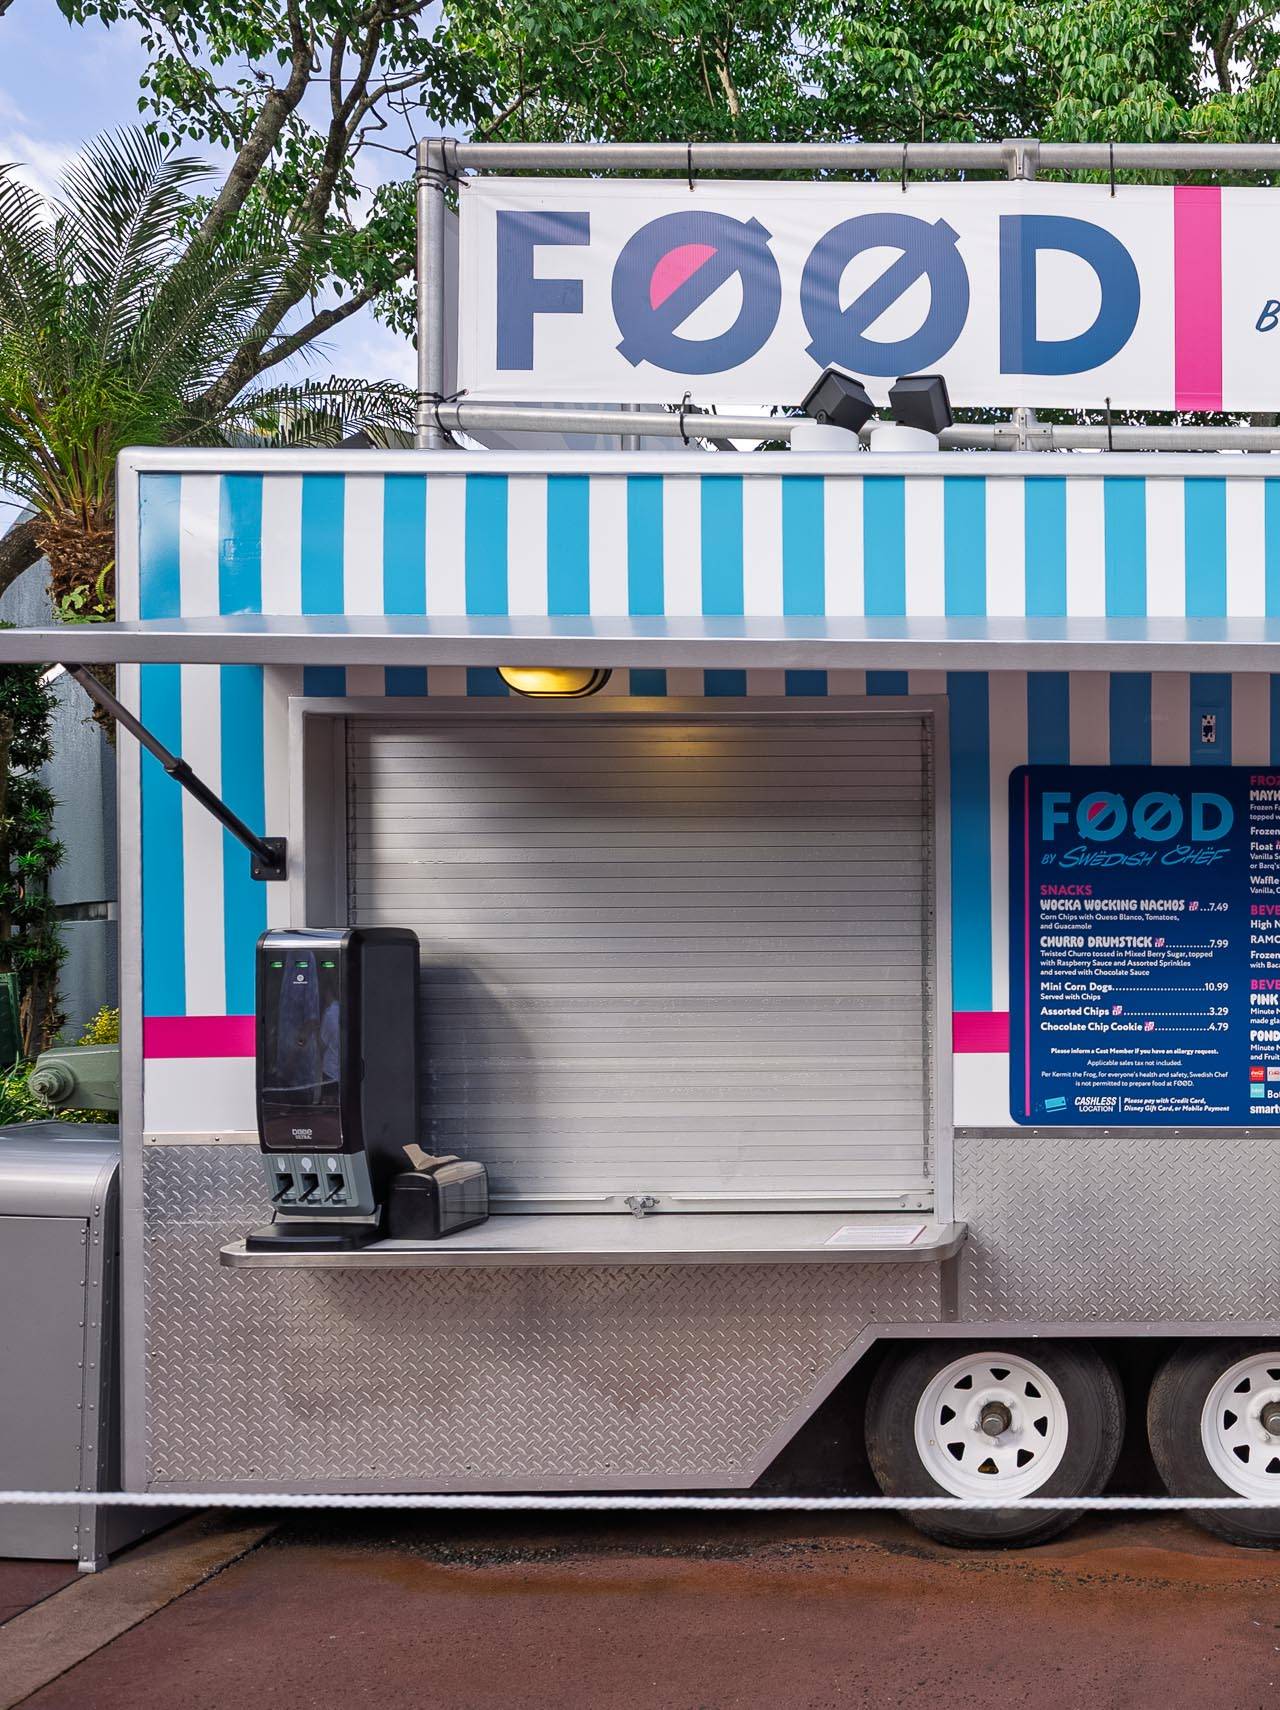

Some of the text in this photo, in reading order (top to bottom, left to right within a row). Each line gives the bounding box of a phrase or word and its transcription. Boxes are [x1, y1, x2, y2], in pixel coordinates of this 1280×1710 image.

[1250, 827, 1280, 835] Frozen
[1250, 842, 1273, 851] Float
[1041, 853, 1056, 864] BY
[1250, 876, 1279, 885] Waffle
[1040, 884, 1092, 896] SNACKS
[1040, 899, 1081, 911] WOCKA
[1084, 899, 1137, 911] WOCKING
[1140, 899, 1185, 911] NACHOS
[1058, 914, 1077, 922] Chips
[1250, 921, 1271, 930] High
[1040, 936, 1084, 948] CHURRO
[1088, 936, 1152, 948] DRUMSTICK
[1147, 950, 1165, 958] Berry
[1188, 950, 1213, 958] topped
[1250, 951, 1280, 959] Frozen
[1057, 960, 1091, 968] Raspberry
[1159, 960, 1191, 968] Sprinkles
[1040, 983, 1061, 991] Mini
[1064, 983, 1086, 991] Corn
[1081, 993, 1101, 1001] Chips
[1250, 994, 1278, 1005] PINK
[1040, 1007, 1081, 1015] Assorted
[1083, 1007, 1110, 1017] Chips
[1040, 1022, 1086, 1031] Chocolate
[1088, 1022, 1109, 1032] Chip
[1111, 1022, 1143, 1031] Cookie
[1250, 1030, 1280, 1042] POND
[1087, 1059, 1118, 1067] Applicable
[1075, 1097, 1117, 1105] CASHLESS
